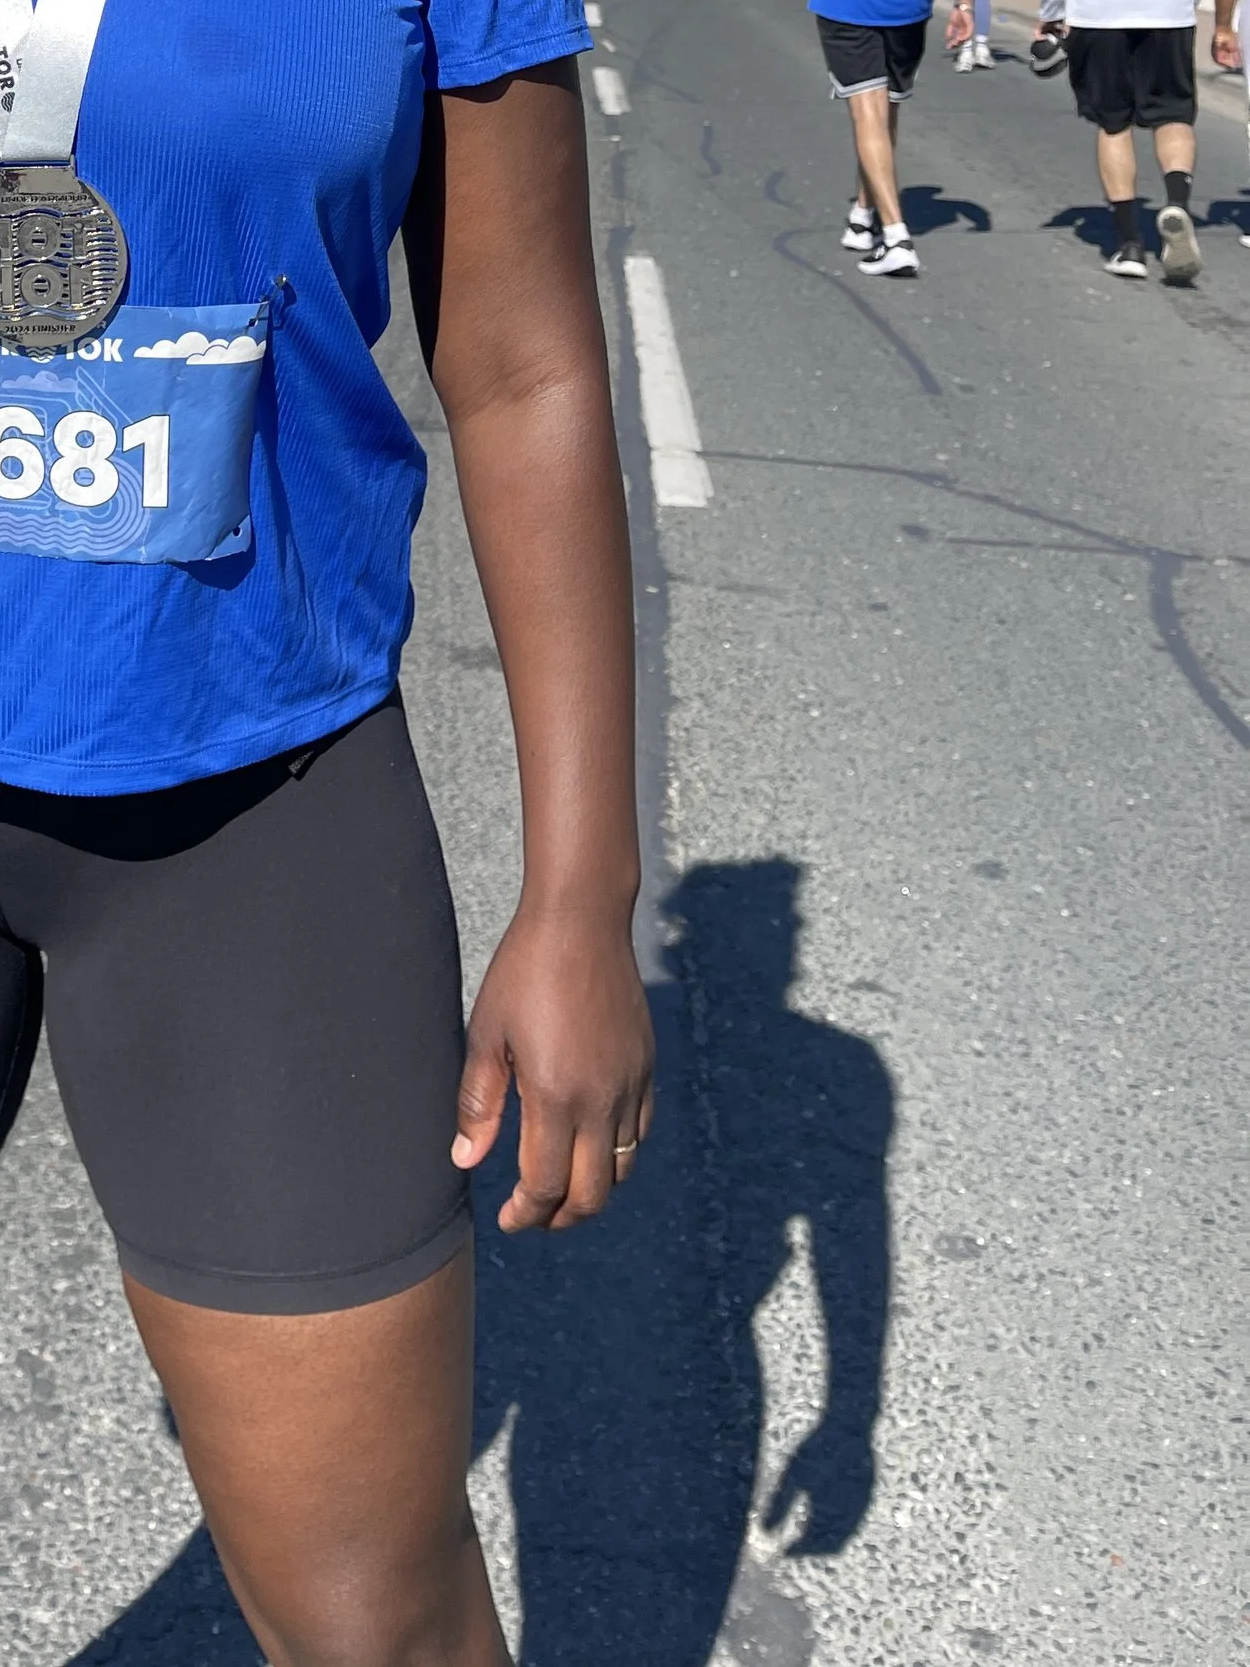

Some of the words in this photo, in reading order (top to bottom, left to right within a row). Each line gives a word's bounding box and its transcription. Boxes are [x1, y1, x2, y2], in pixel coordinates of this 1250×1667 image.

[5, 325, 30, 334] 2024
[32, 325, 76, 334] FINISHER
[65, 336, 124, 362] 10K
